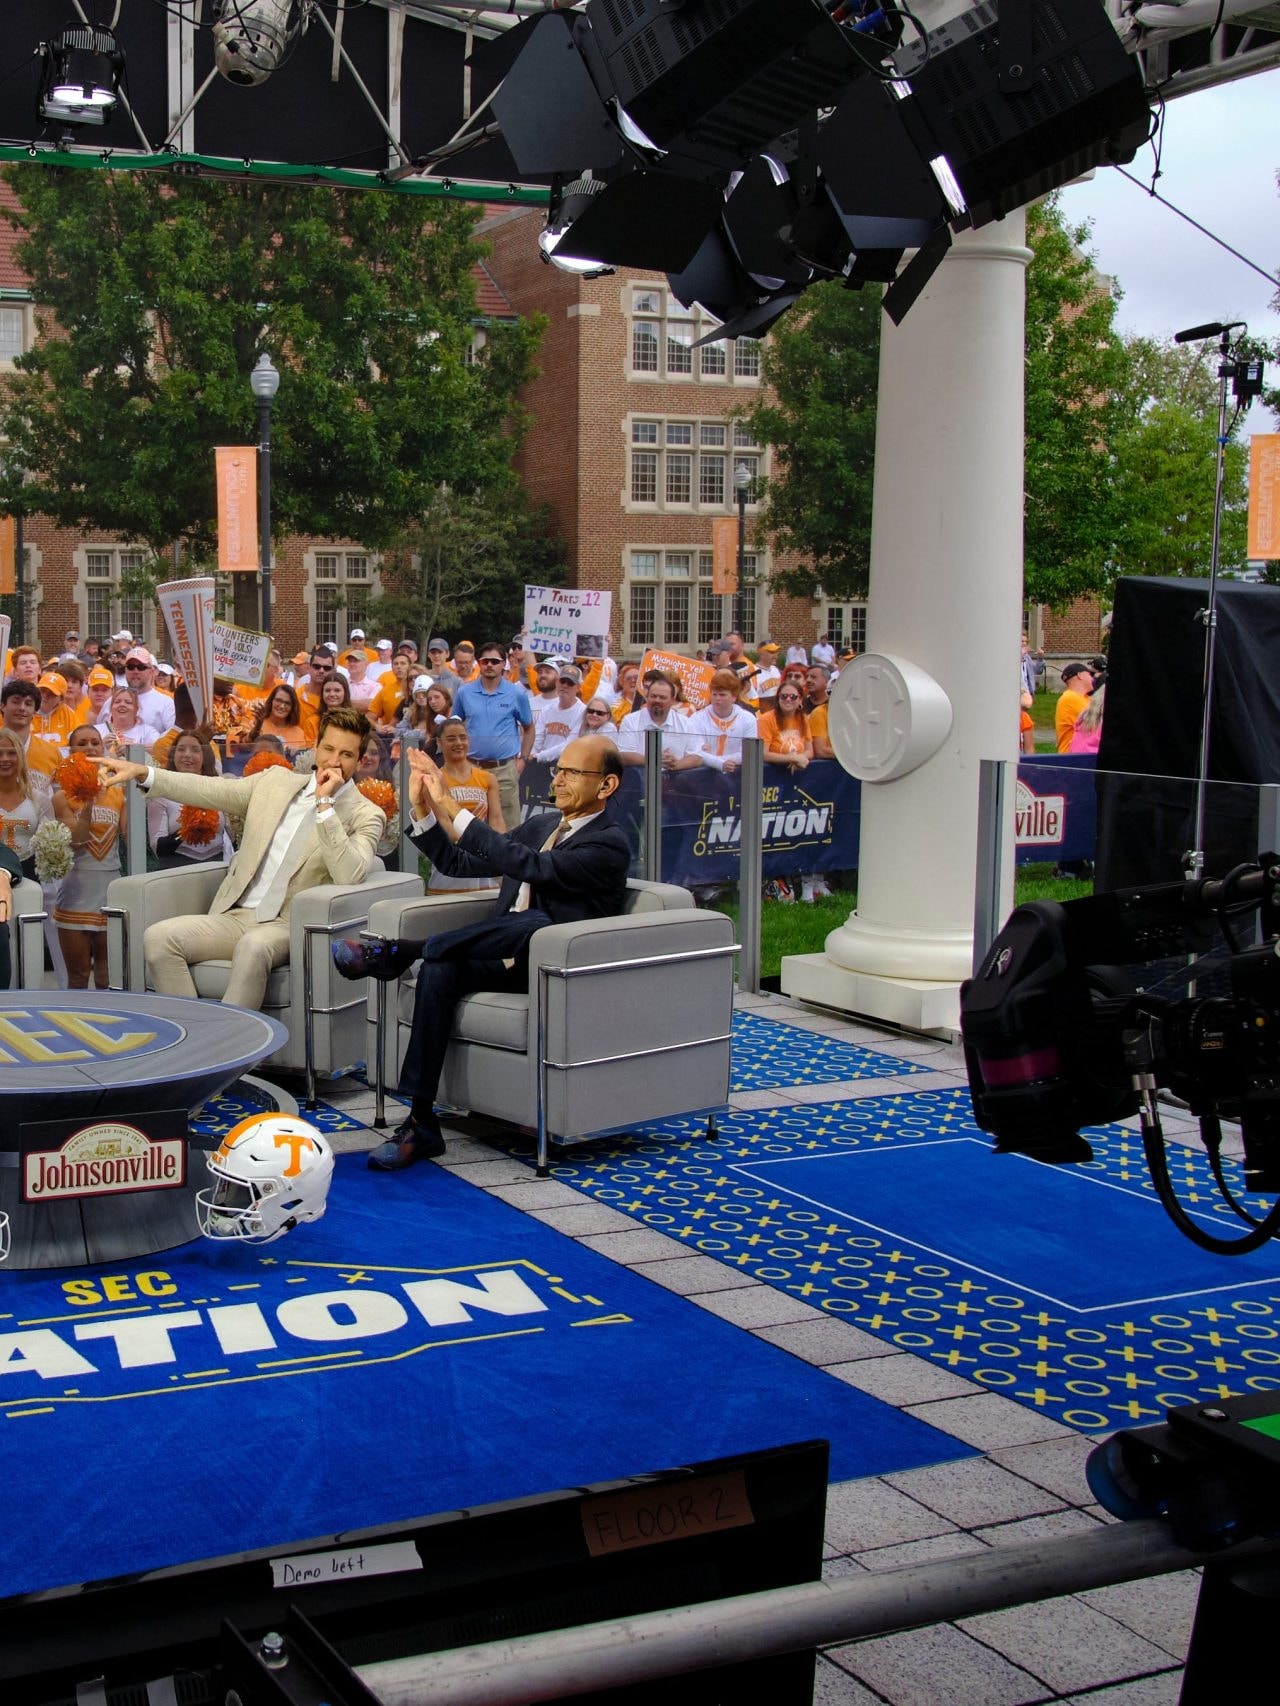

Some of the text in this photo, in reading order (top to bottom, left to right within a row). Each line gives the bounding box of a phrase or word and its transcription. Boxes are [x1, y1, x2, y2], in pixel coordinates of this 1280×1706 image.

[526, 587, 601, 607] IT TAKES 12
[538, 605, 582, 618] MEN TO
[170, 599, 200, 689] TENNESSEE
[529, 638, 572, 653] JIMBO
[651, 654, 687, 669] Midnight
[1015, 800, 1058, 837] ville
[32, 1145, 177, 1194] Johnsonville
[272, 1133, 314, 1179] T
[61, 1270, 179, 1306] SEC
[592, 1486, 737, 1548] FLOOR 2
[283, 1562, 321, 1585] Demo
